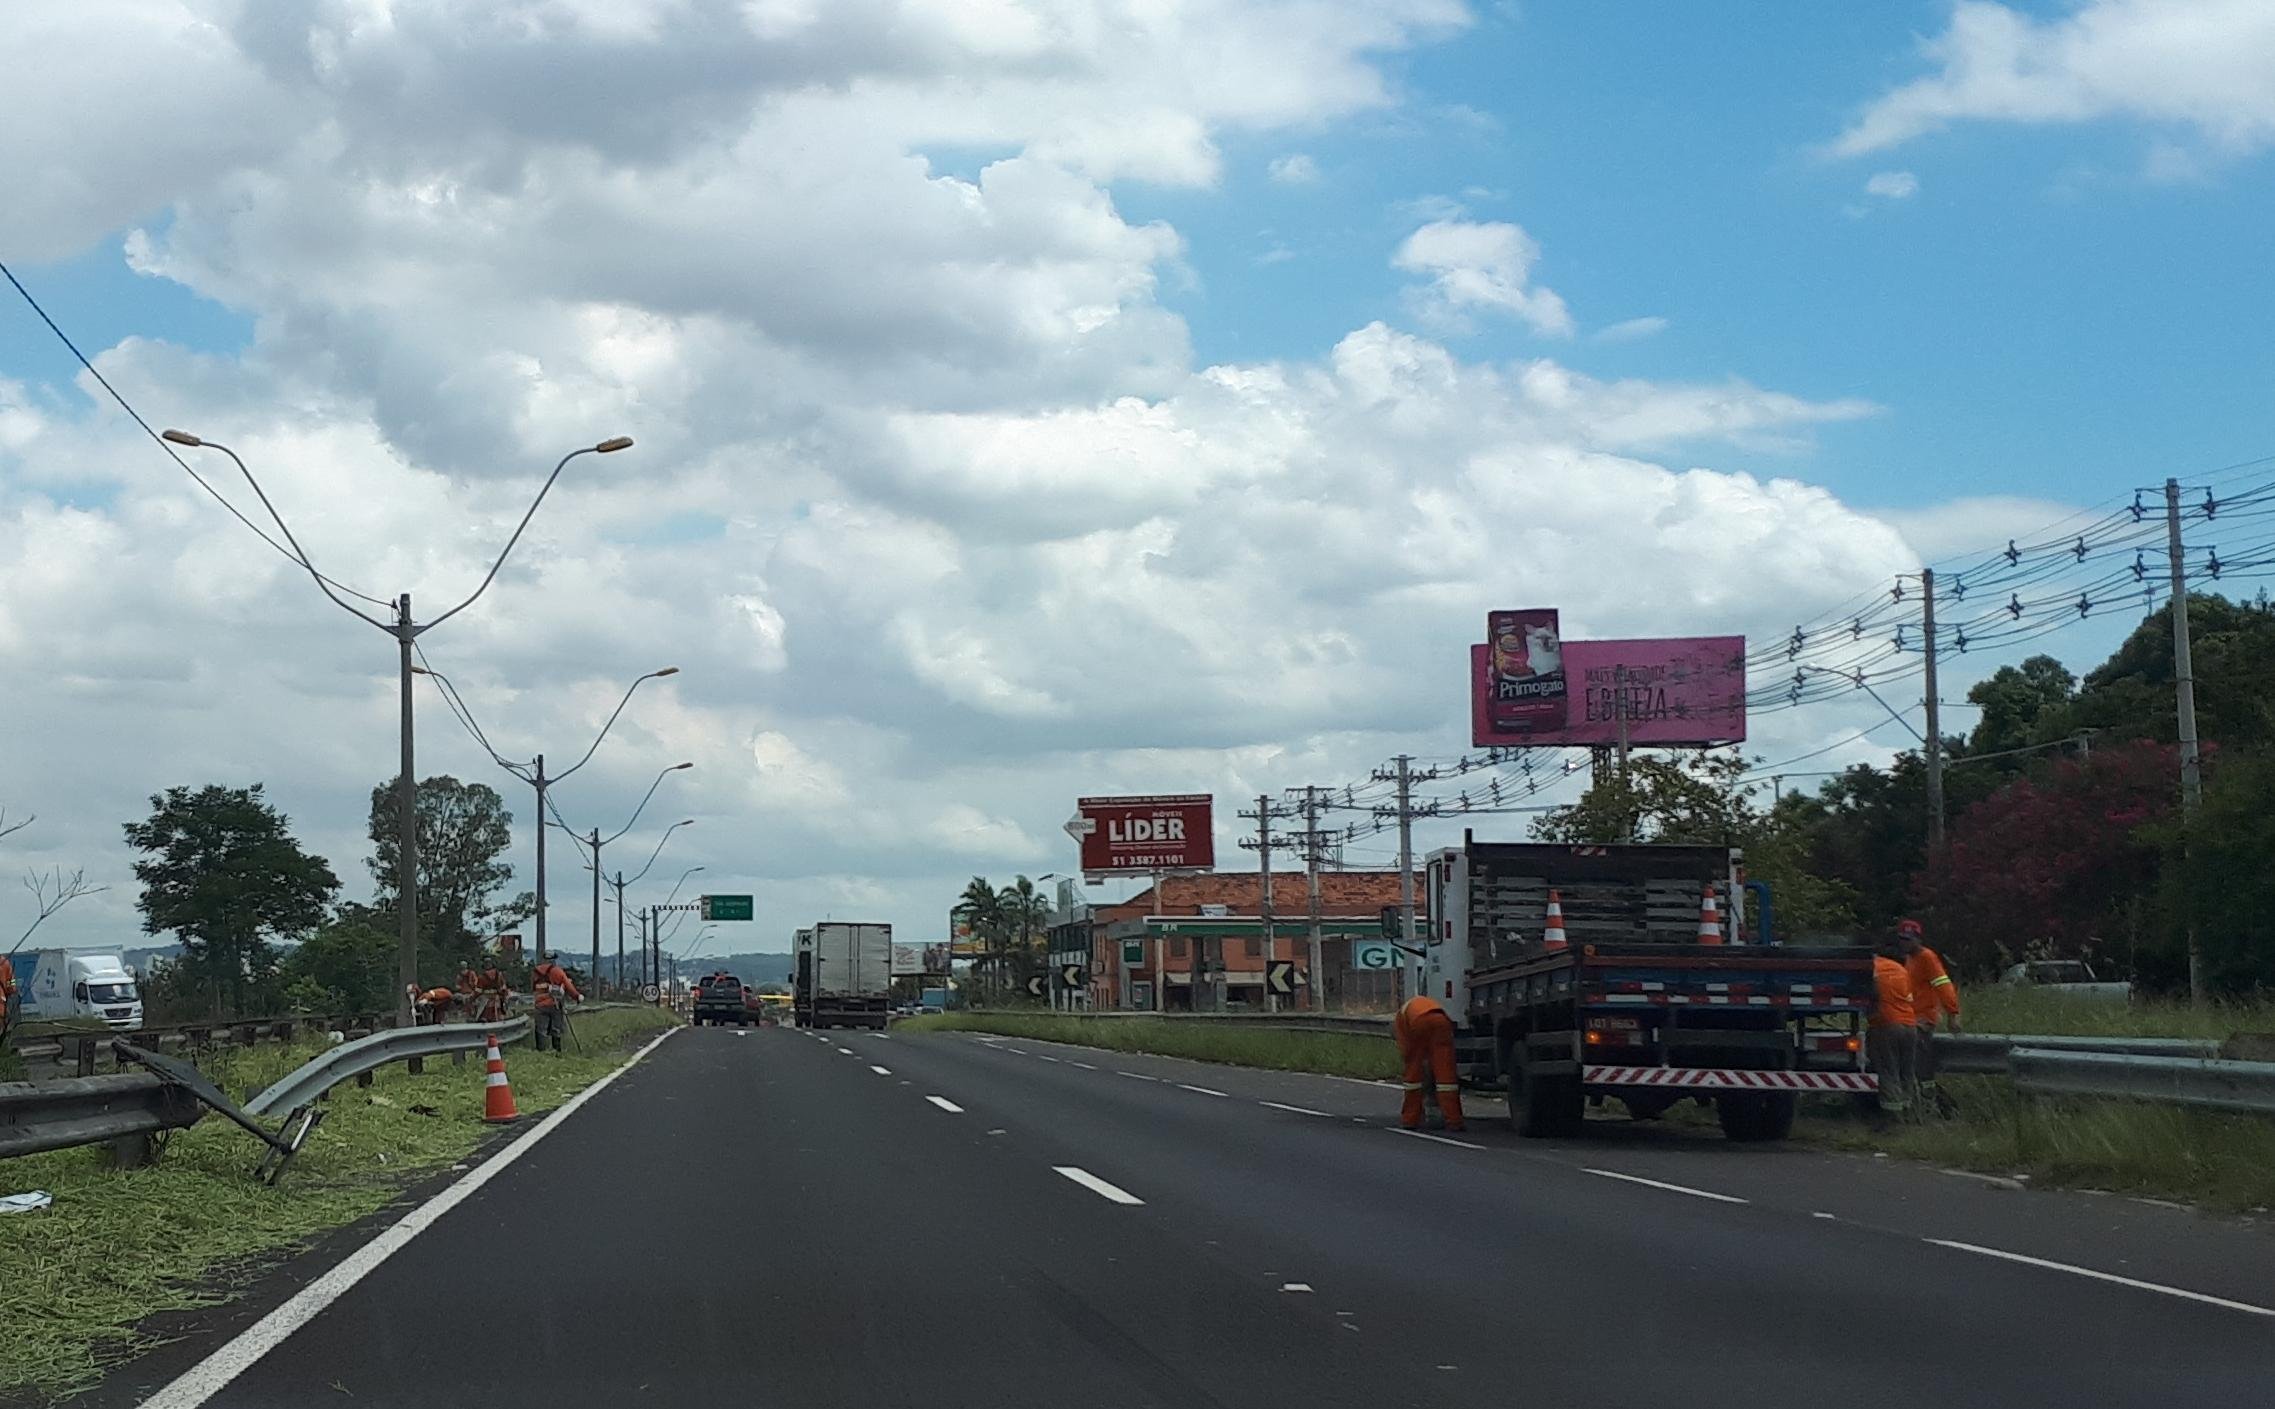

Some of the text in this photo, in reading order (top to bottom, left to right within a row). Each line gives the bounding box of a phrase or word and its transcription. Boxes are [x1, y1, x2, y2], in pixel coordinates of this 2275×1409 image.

[1500, 681, 1564, 699] Primogato
[1109, 812, 1186, 841] LÍDER
[1112, 856, 1126, 866] 51
[644, 986, 658, 997] 60
